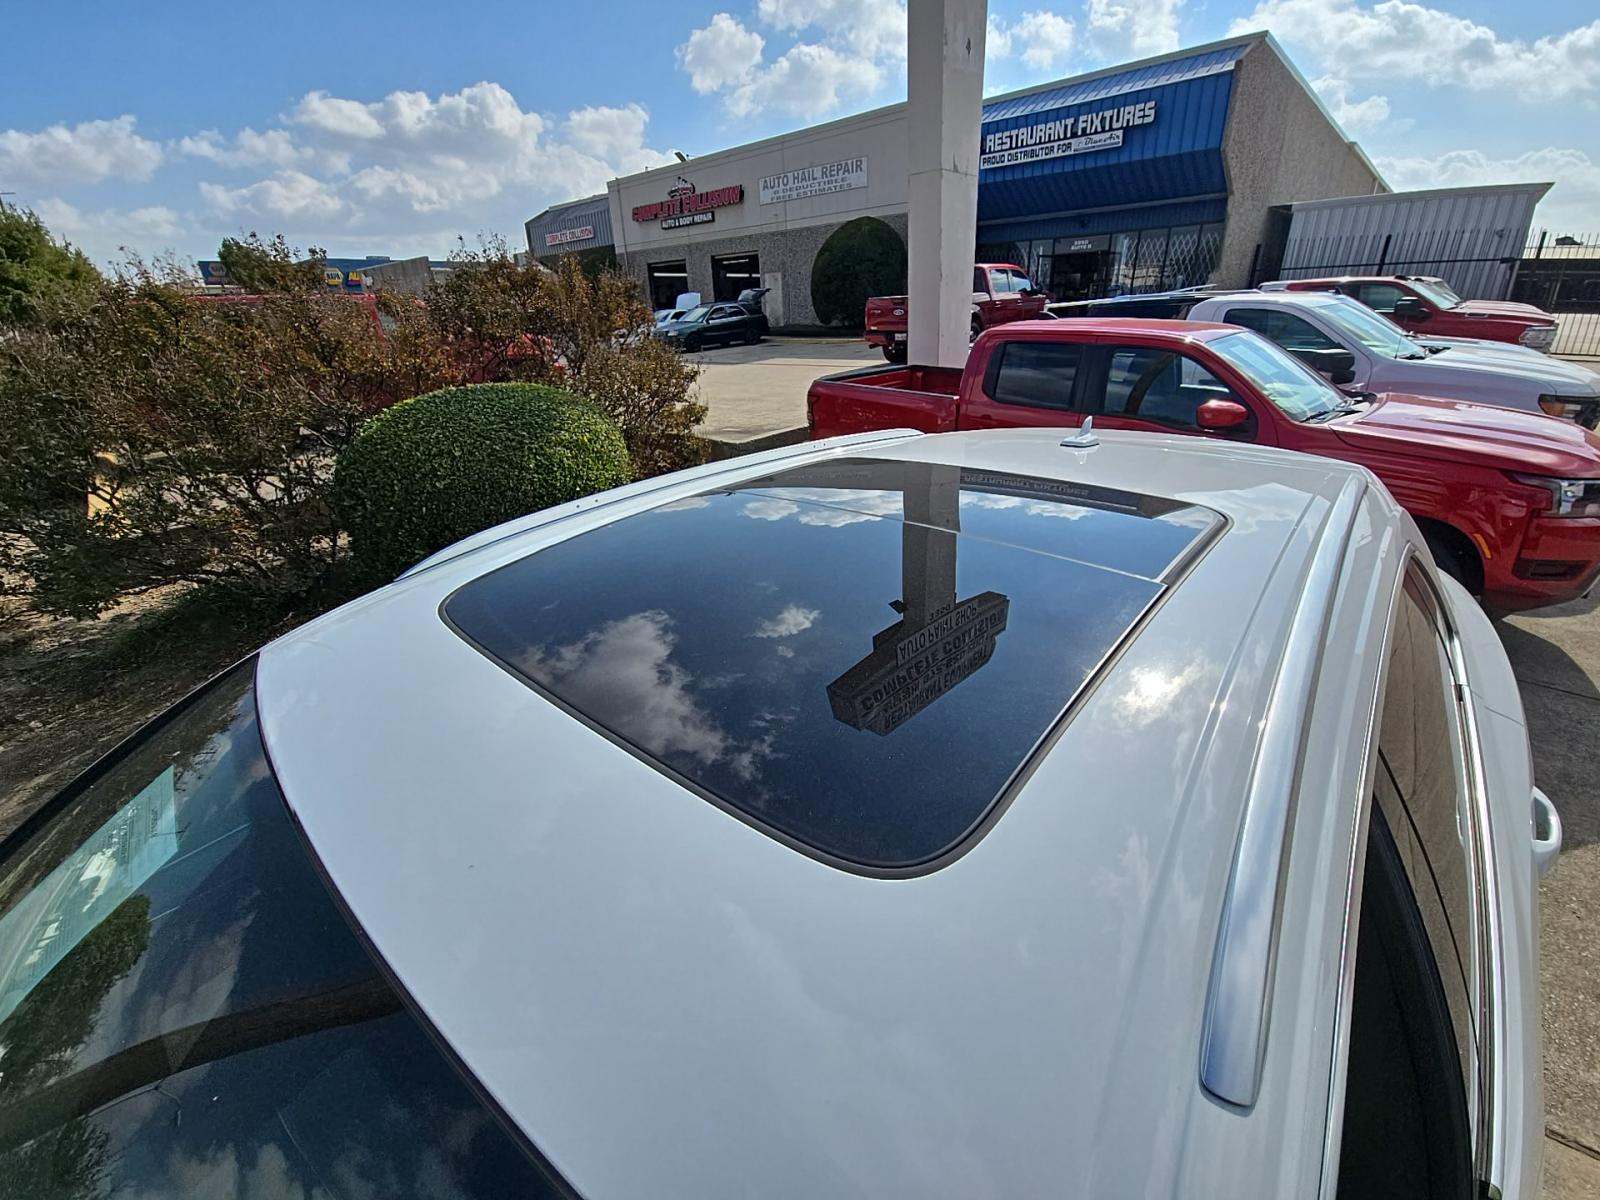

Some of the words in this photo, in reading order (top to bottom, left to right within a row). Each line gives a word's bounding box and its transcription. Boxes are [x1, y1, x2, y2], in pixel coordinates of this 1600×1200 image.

[986, 117, 1075, 153] RESTAURANT
[1077, 100, 1156, 136] FIXTURES
[982, 154, 1006, 167] PROUD
[1007, 145, 1055, 162] DISTRIBUTOR
[1057, 141, 1072, 154] FOR
[762, 174, 789, 191] AUTO
[792, 168, 818, 186] HAIL
[821, 159, 863, 180] REPAIR
[781, 176, 848, 194] DEDUCTIBLE
[770, 193, 794, 201] FREE
[796, 182, 852, 198] ESTIMATES
[632, 196, 682, 223] COMPLETE
[682, 184, 745, 214] COLLISION
[662, 218, 675, 229] AUTO
[679, 216, 693, 226] BODY
[693, 212, 713, 223] REPAIR
[546, 232, 568, 244] COMPLETE
[568, 228, 592, 241] COLLISION
